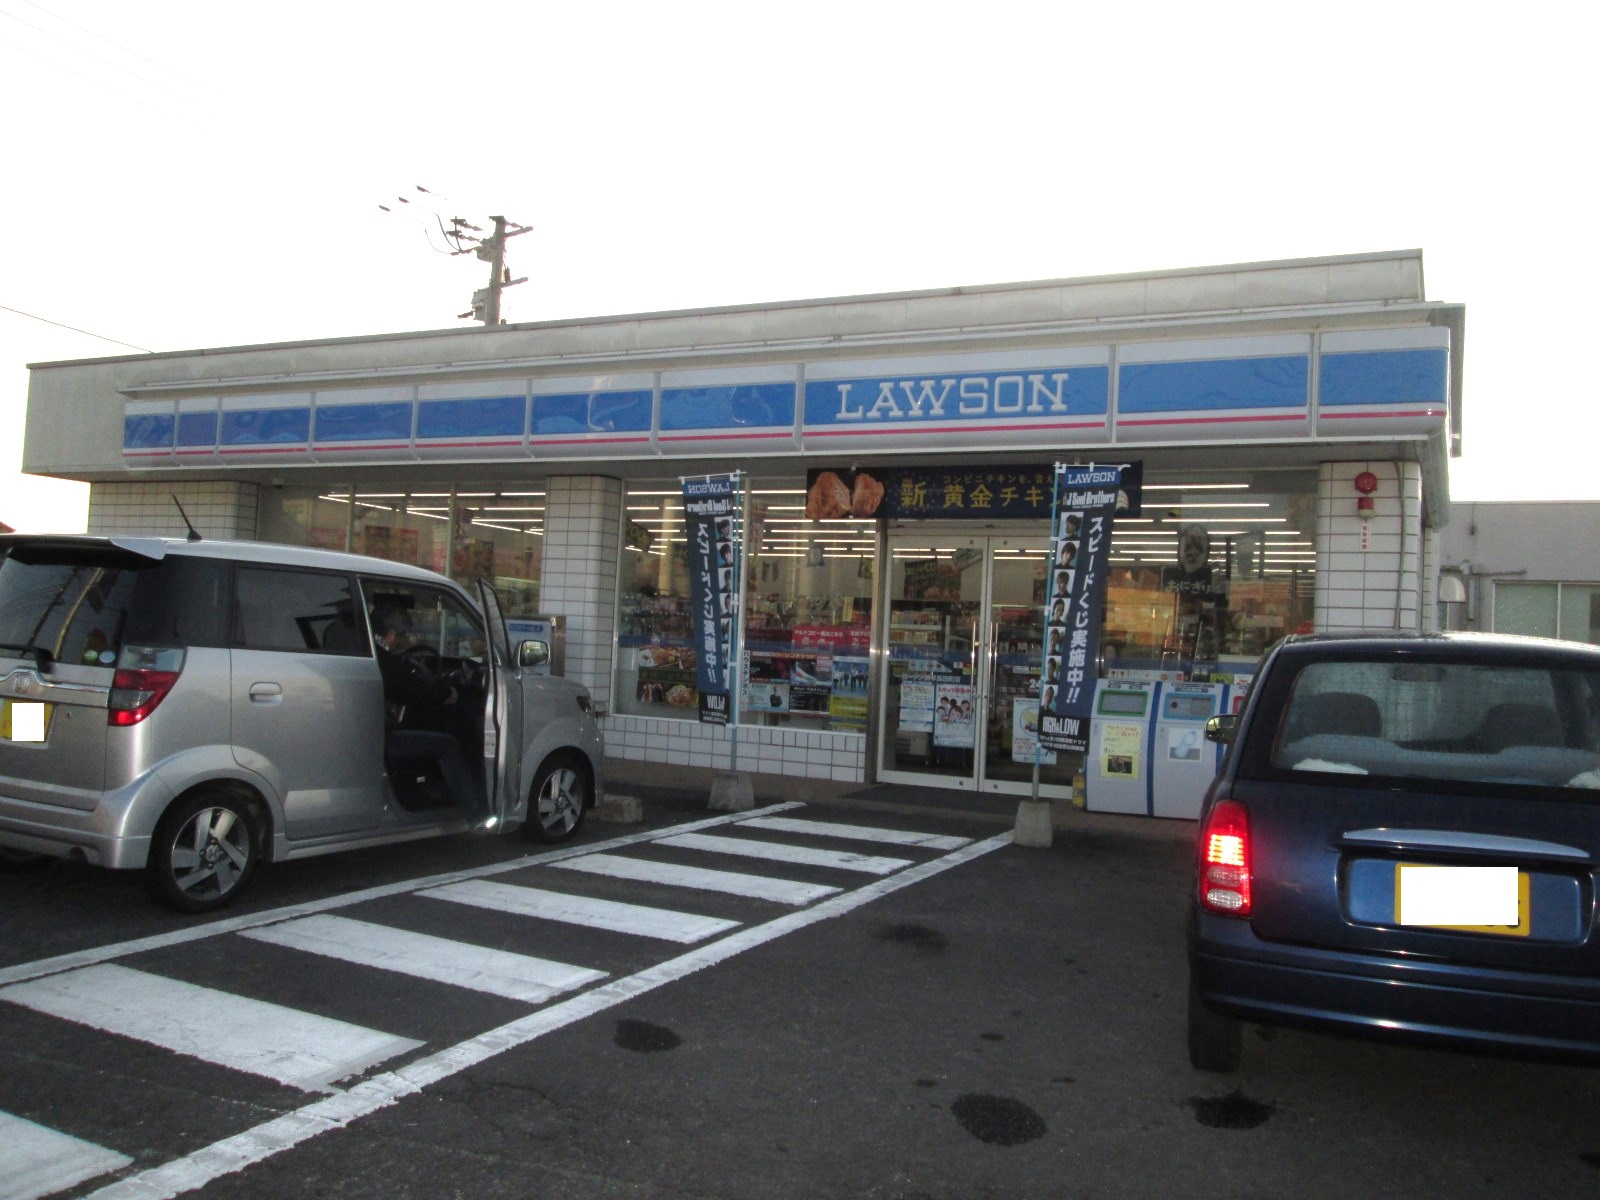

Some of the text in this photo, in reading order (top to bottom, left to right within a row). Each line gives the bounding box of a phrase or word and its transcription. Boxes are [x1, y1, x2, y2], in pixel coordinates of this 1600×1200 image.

[836, 373, 1069, 420] LAWSON
[901, 477, 927, 508] 新
[1067, 471, 1117, 485] LAWSON
[1072, 491, 1087, 506] Soul
[1086, 490, 1116, 505] Brothers
[1065, 516, 1104, 704] スピードくじ実施中!!
